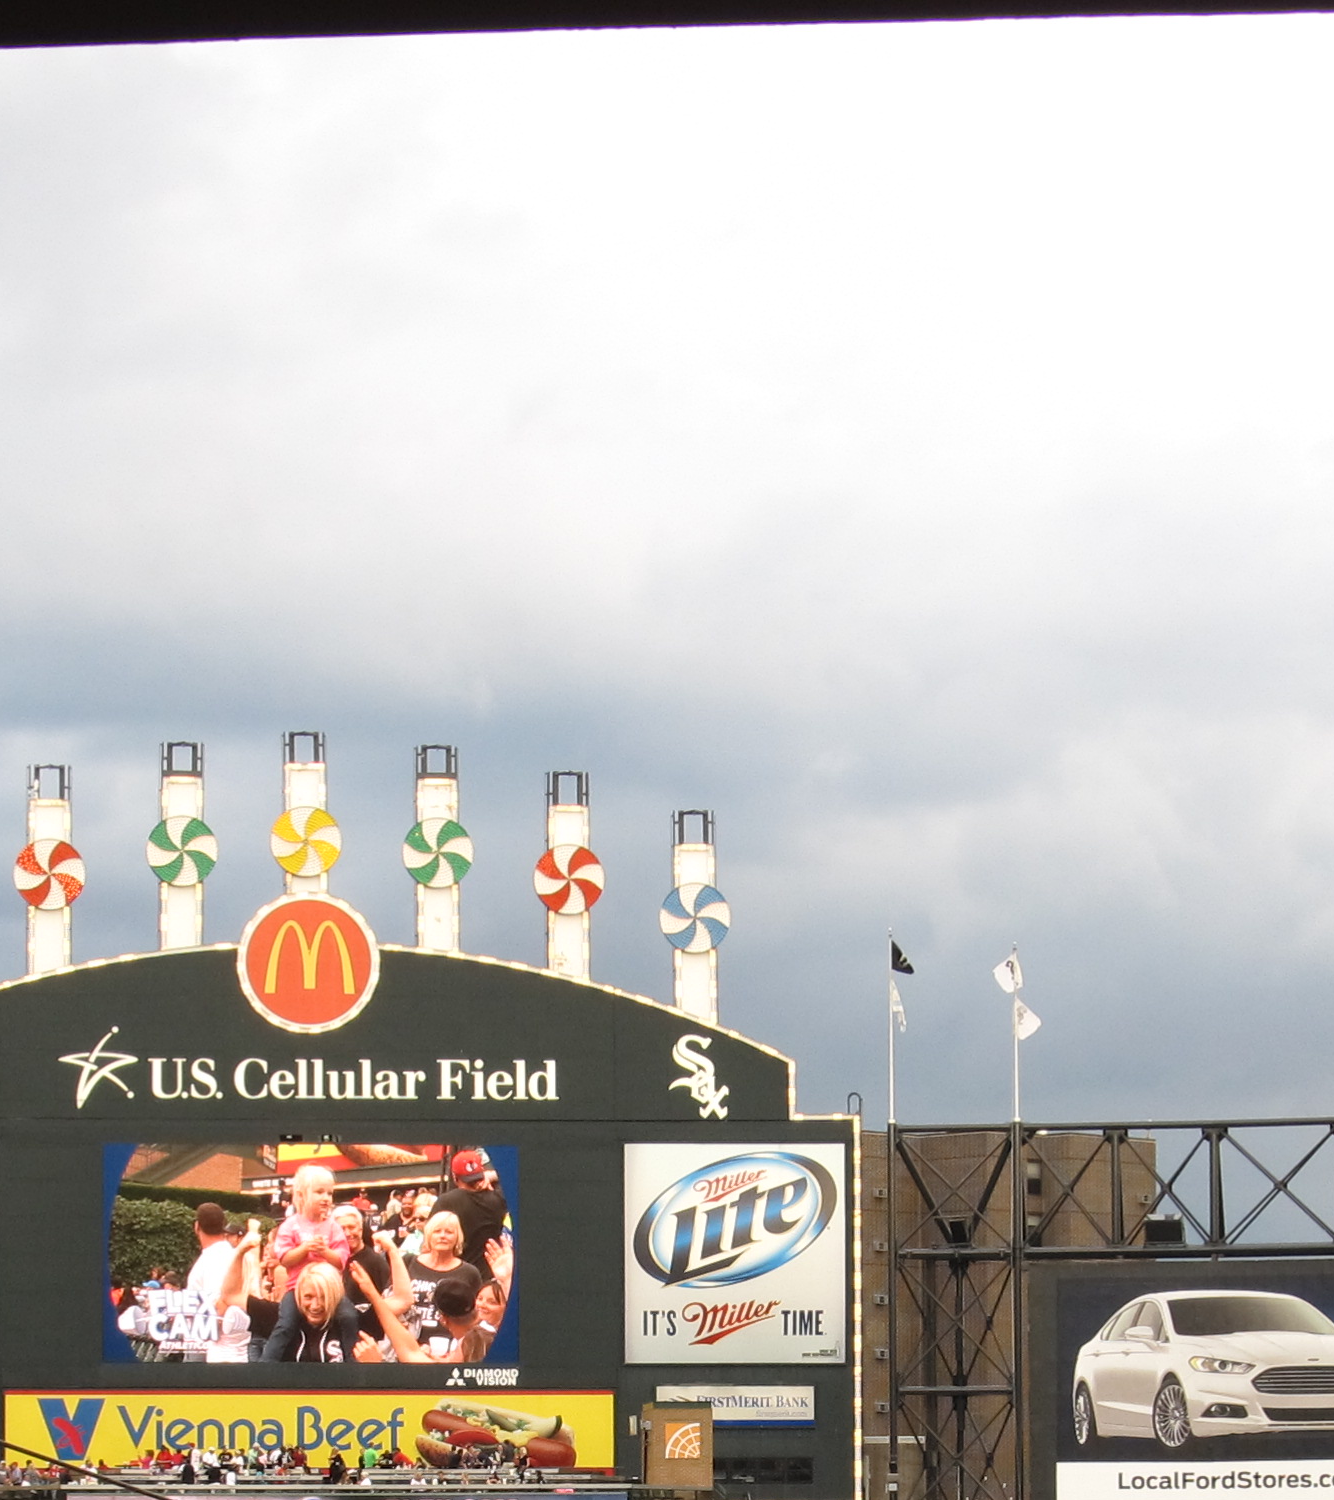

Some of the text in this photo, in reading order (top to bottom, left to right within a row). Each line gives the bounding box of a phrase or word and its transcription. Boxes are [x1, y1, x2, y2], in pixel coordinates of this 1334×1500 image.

[147, 1056, 559, 1101] U.S. Cellular Field
[693, 1169, 768, 1204] Miller
[662, 1177, 808, 1287] Lite
[148, 1288, 217, 1315] FLEX
[148, 1313, 218, 1342] CAM
[643, 1310, 677, 1337] IT'S
[682, 1299, 783, 1346] Miller
[476, 1376, 517, 1386] VISION
[776, 1395, 809, 1408] BANK
[117, 1405, 404, 1452] Vienna Beef
